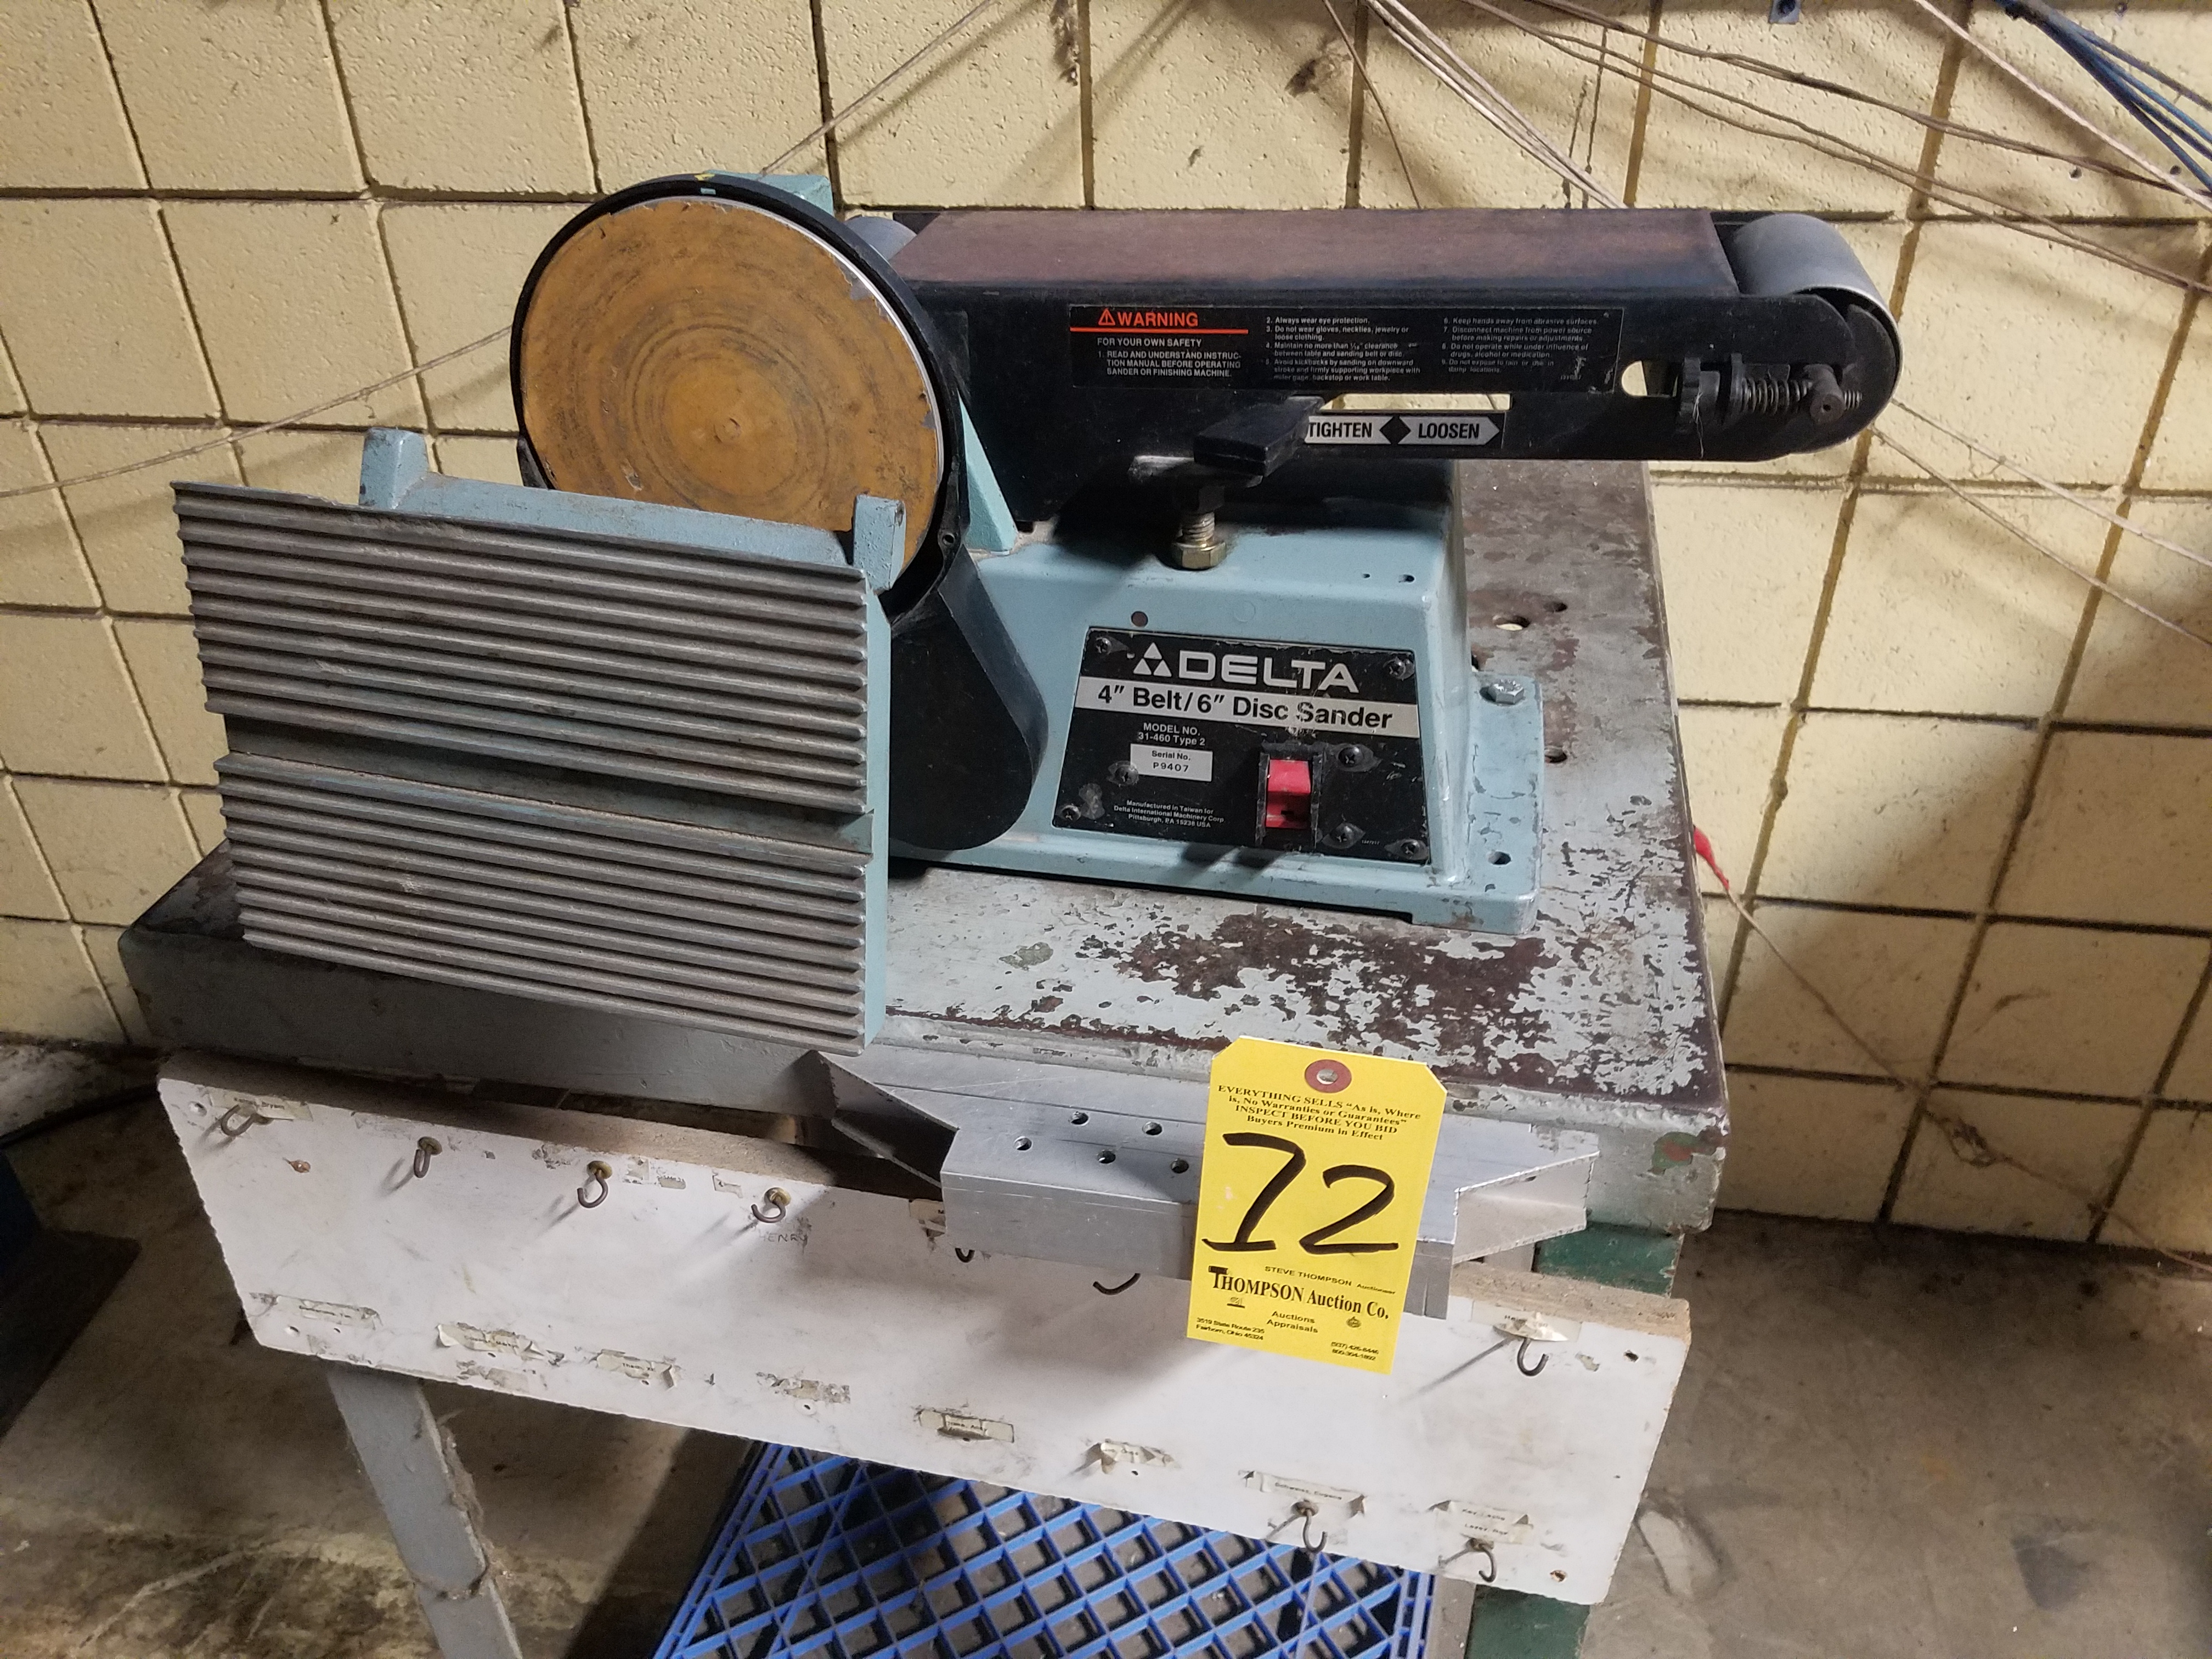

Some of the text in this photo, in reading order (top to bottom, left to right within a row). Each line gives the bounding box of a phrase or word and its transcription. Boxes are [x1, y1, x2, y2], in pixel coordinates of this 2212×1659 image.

[1118, 312, 1198, 326] WARNING
[1097, 337, 1201, 347] FOR YOUR OWN SAFETY
[1148, 351, 1202, 359] UNDERSTAND
[1204, 351, 1242, 359] INSTRUC-
[1107, 359, 1240, 369] TION MANUAL BEFORE OPERATING
[1107, 368, 1138, 376] SANDER
[1153, 368, 1192, 376] FINISHING
[1308, 422, 1372, 438] TIGHTEN
[1418, 423, 1480, 439] LOOSEN
[1179, 649, 1360, 694] DELTA
[1233, 696, 1288, 720] Disc
[1296, 703, 1393, 729] Sander
[1143, 723, 1200, 736] MODEL NO.
[1138, 732, 1170, 743] 31-460
[1173, 735, 1197, 746] Type
[1152, 750, 1175, 758] Serial
[1153, 762, 1189, 772] P9407
[1126, 800, 1171, 810] Manufactured
[1180, 805, 1203, 814] Taiwan
[1128, 814, 1164, 823] Pittsburgh,
[1131, 808, 1172, 817] International
[1173, 811, 1206, 821] Machinery
[1218, 1085, 1301, 1103] EVERYTHING
[1304, 1097, 1342, 1108] SELLS
[1369, 1106, 1380, 1115] is,
[1385, 1108, 1420, 1119] Where
[1262, 1100, 1320, 1114] Warranties
[1235, 1105, 1397, 1133] INSPECT BEFORE YOU BID
[1247, 1115, 1283, 1126] Buyers
[1286, 1121, 1334, 1133] Premium
[1351, 1130, 1383, 1140] Effect
[1201, 1132, 1399, 1255] 72
[1265, 1266, 1295, 1276] STEVE
[1297, 1272, 1352, 1286] THOMPSON
[1307, 1290, 1362, 1313] Auction
[1367, 1301, 1389, 1319] Co.
[1272, 1310, 1315, 1324] Auctions
[1266, 1319, 1318, 1333] Appraisals
